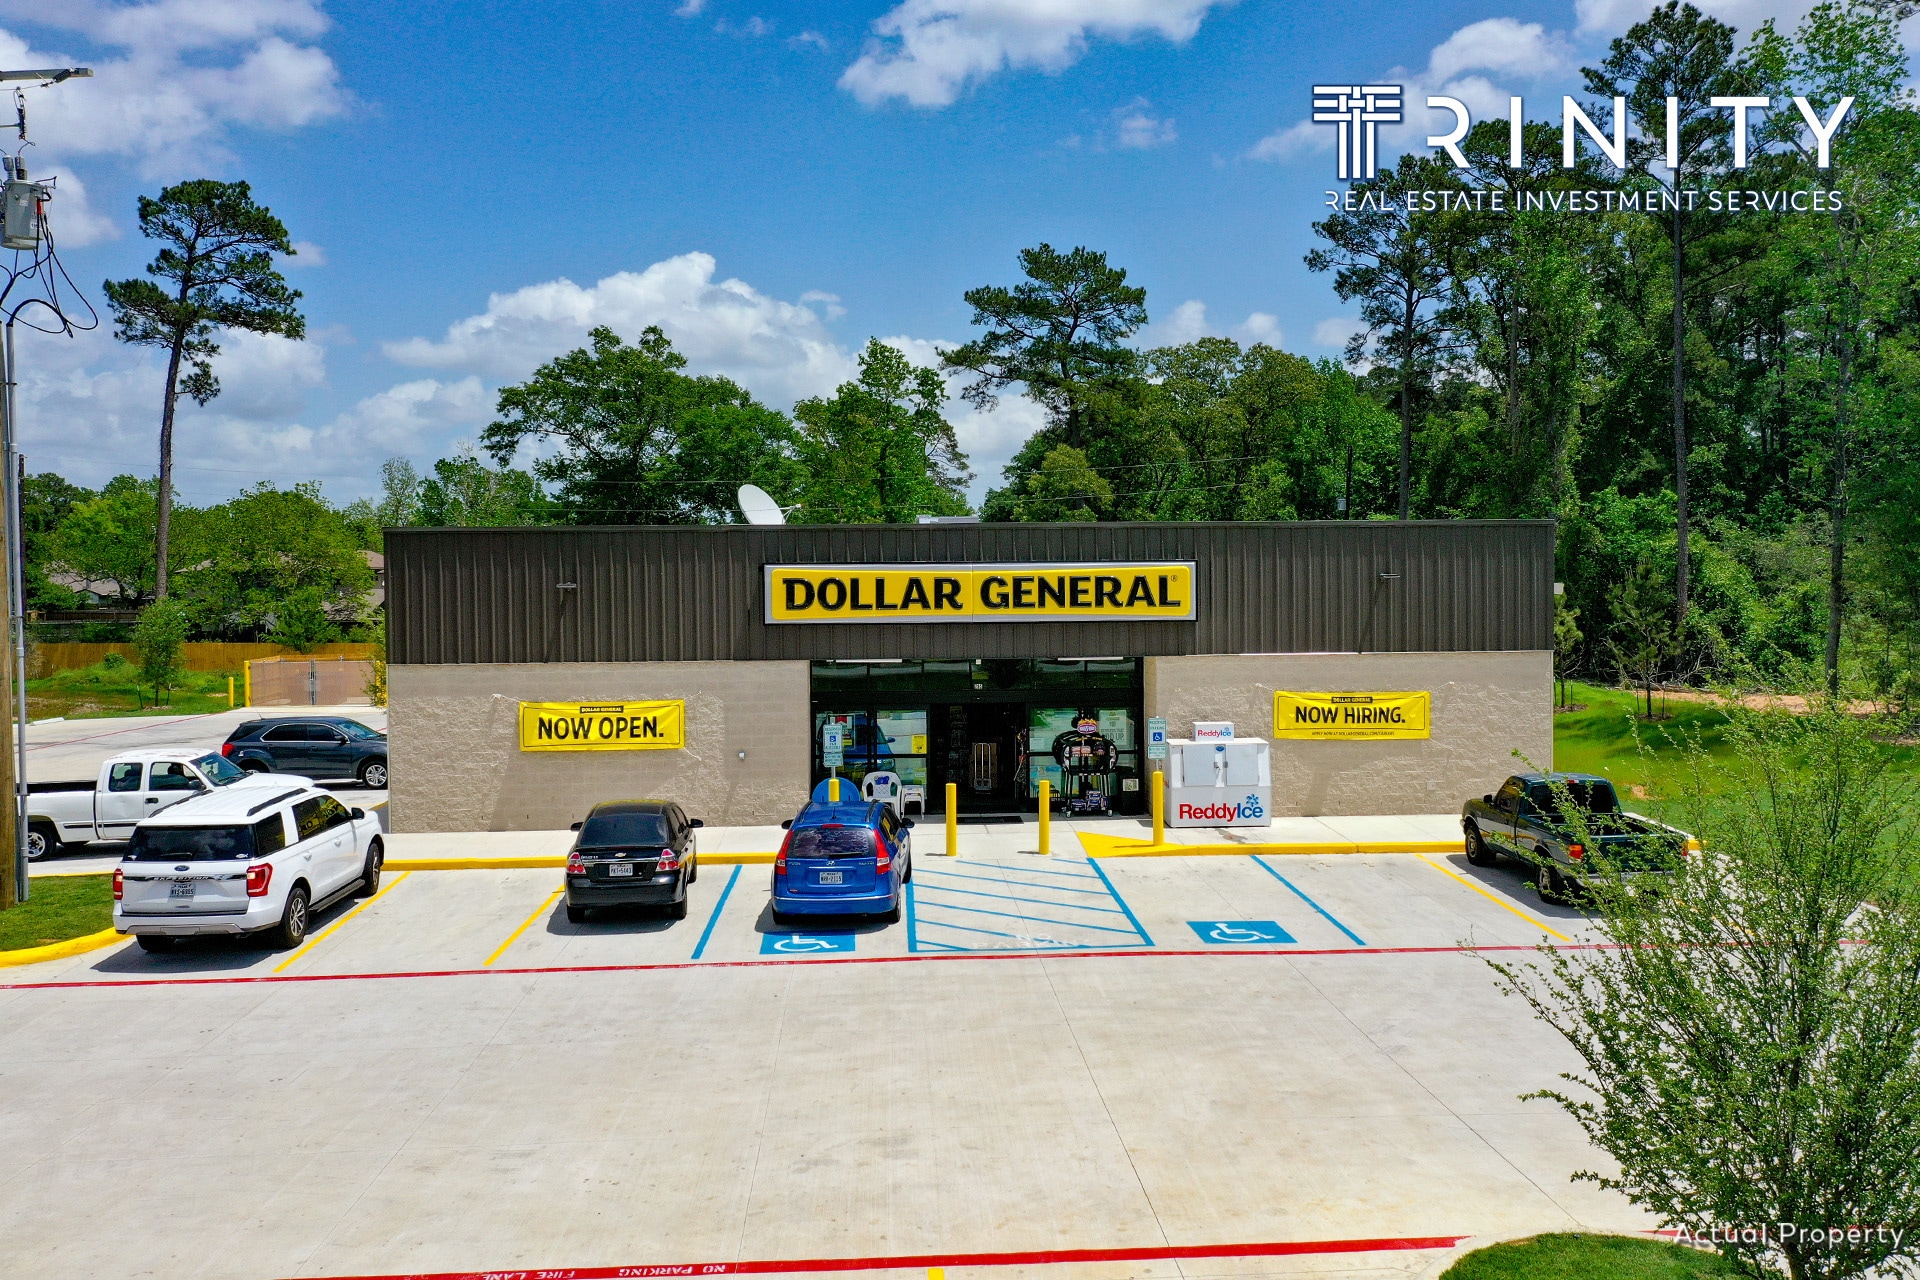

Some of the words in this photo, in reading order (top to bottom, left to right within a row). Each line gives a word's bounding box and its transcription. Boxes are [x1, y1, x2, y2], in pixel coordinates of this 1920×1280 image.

[782, 577, 964, 611] DOLLAR
[979, 575, 1182, 609] GENERAL
[1295, 706, 1339, 724] NOW
[1344, 706, 1406, 724] HIRING.
[538, 717, 593, 740] NOW
[599, 716, 664, 739] OPEN.
[535, 1270, 576, 1280] FIRE
[619, 1265, 693, 1277] PARKING
[702, 1264, 726, 1274] NO
[482, 1272, 526, 1280] LANE
